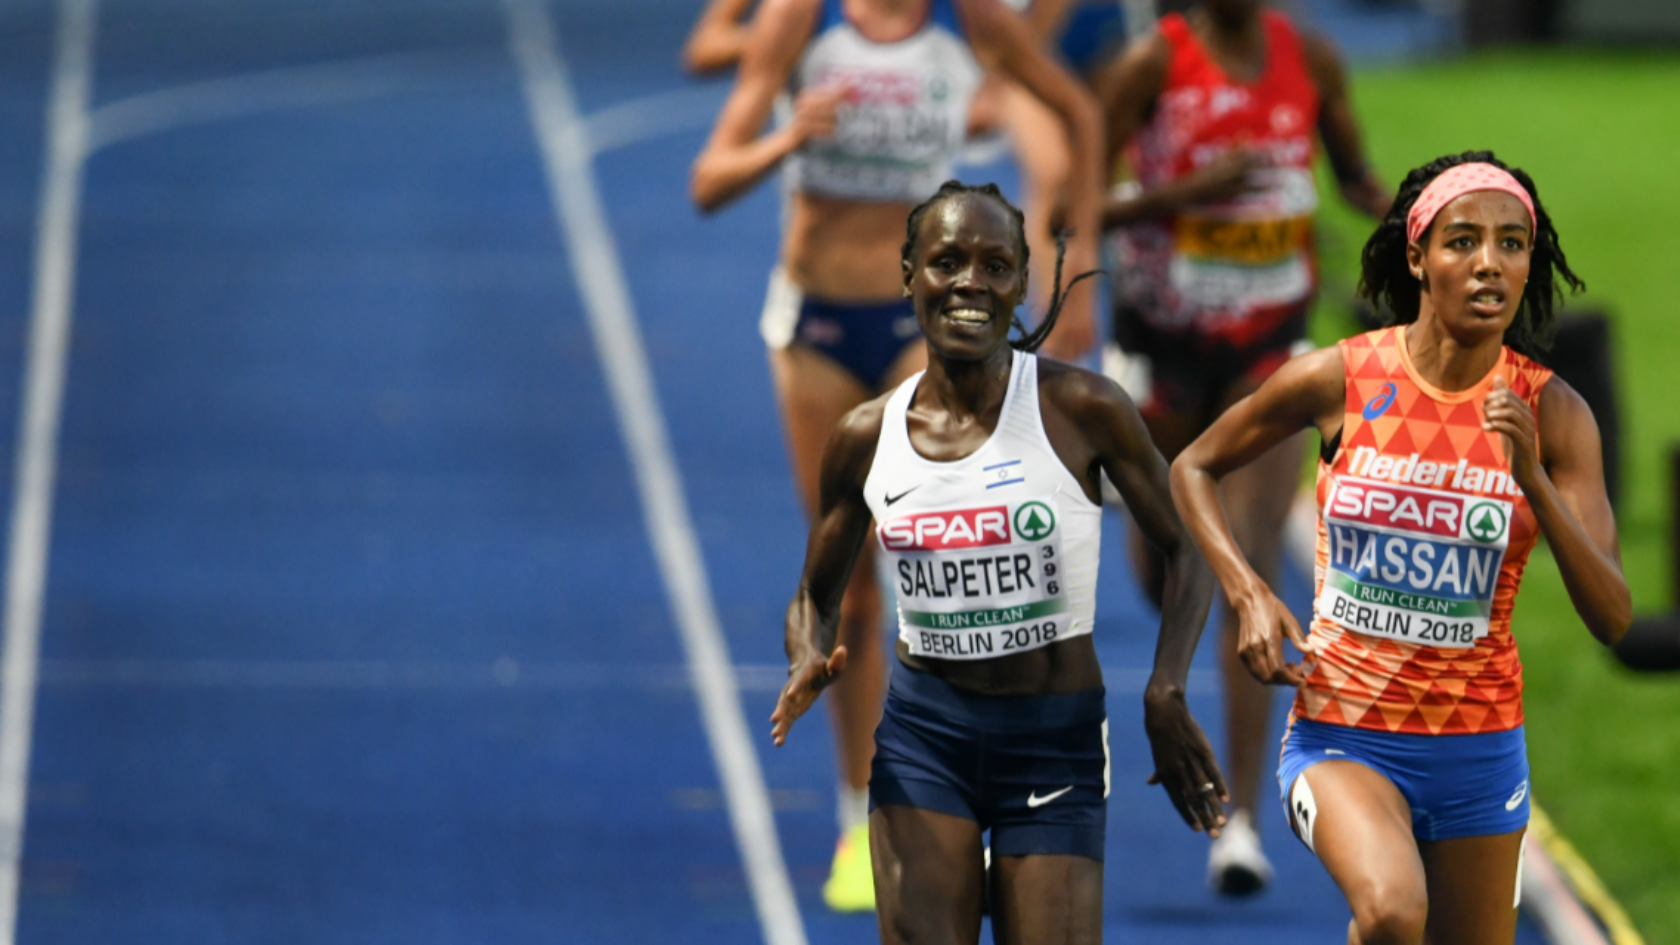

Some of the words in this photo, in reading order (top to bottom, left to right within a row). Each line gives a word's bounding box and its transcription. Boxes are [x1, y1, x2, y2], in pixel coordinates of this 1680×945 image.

[883, 511, 1008, 547] SPAR
[1333, 486, 1459, 532] SPAR
[897, 553, 1035, 598] SALPETER
[1333, 525, 1494, 595] HASSAN
[1360, 586, 1395, 605] RUN
[920, 630, 994, 655] BERLIN
[1001, 621, 1058, 650] 2018
[938, 613, 970, 628] RUN
[1332, 596, 1411, 636] BERLIN
[1418, 618, 1475, 643] 2018
